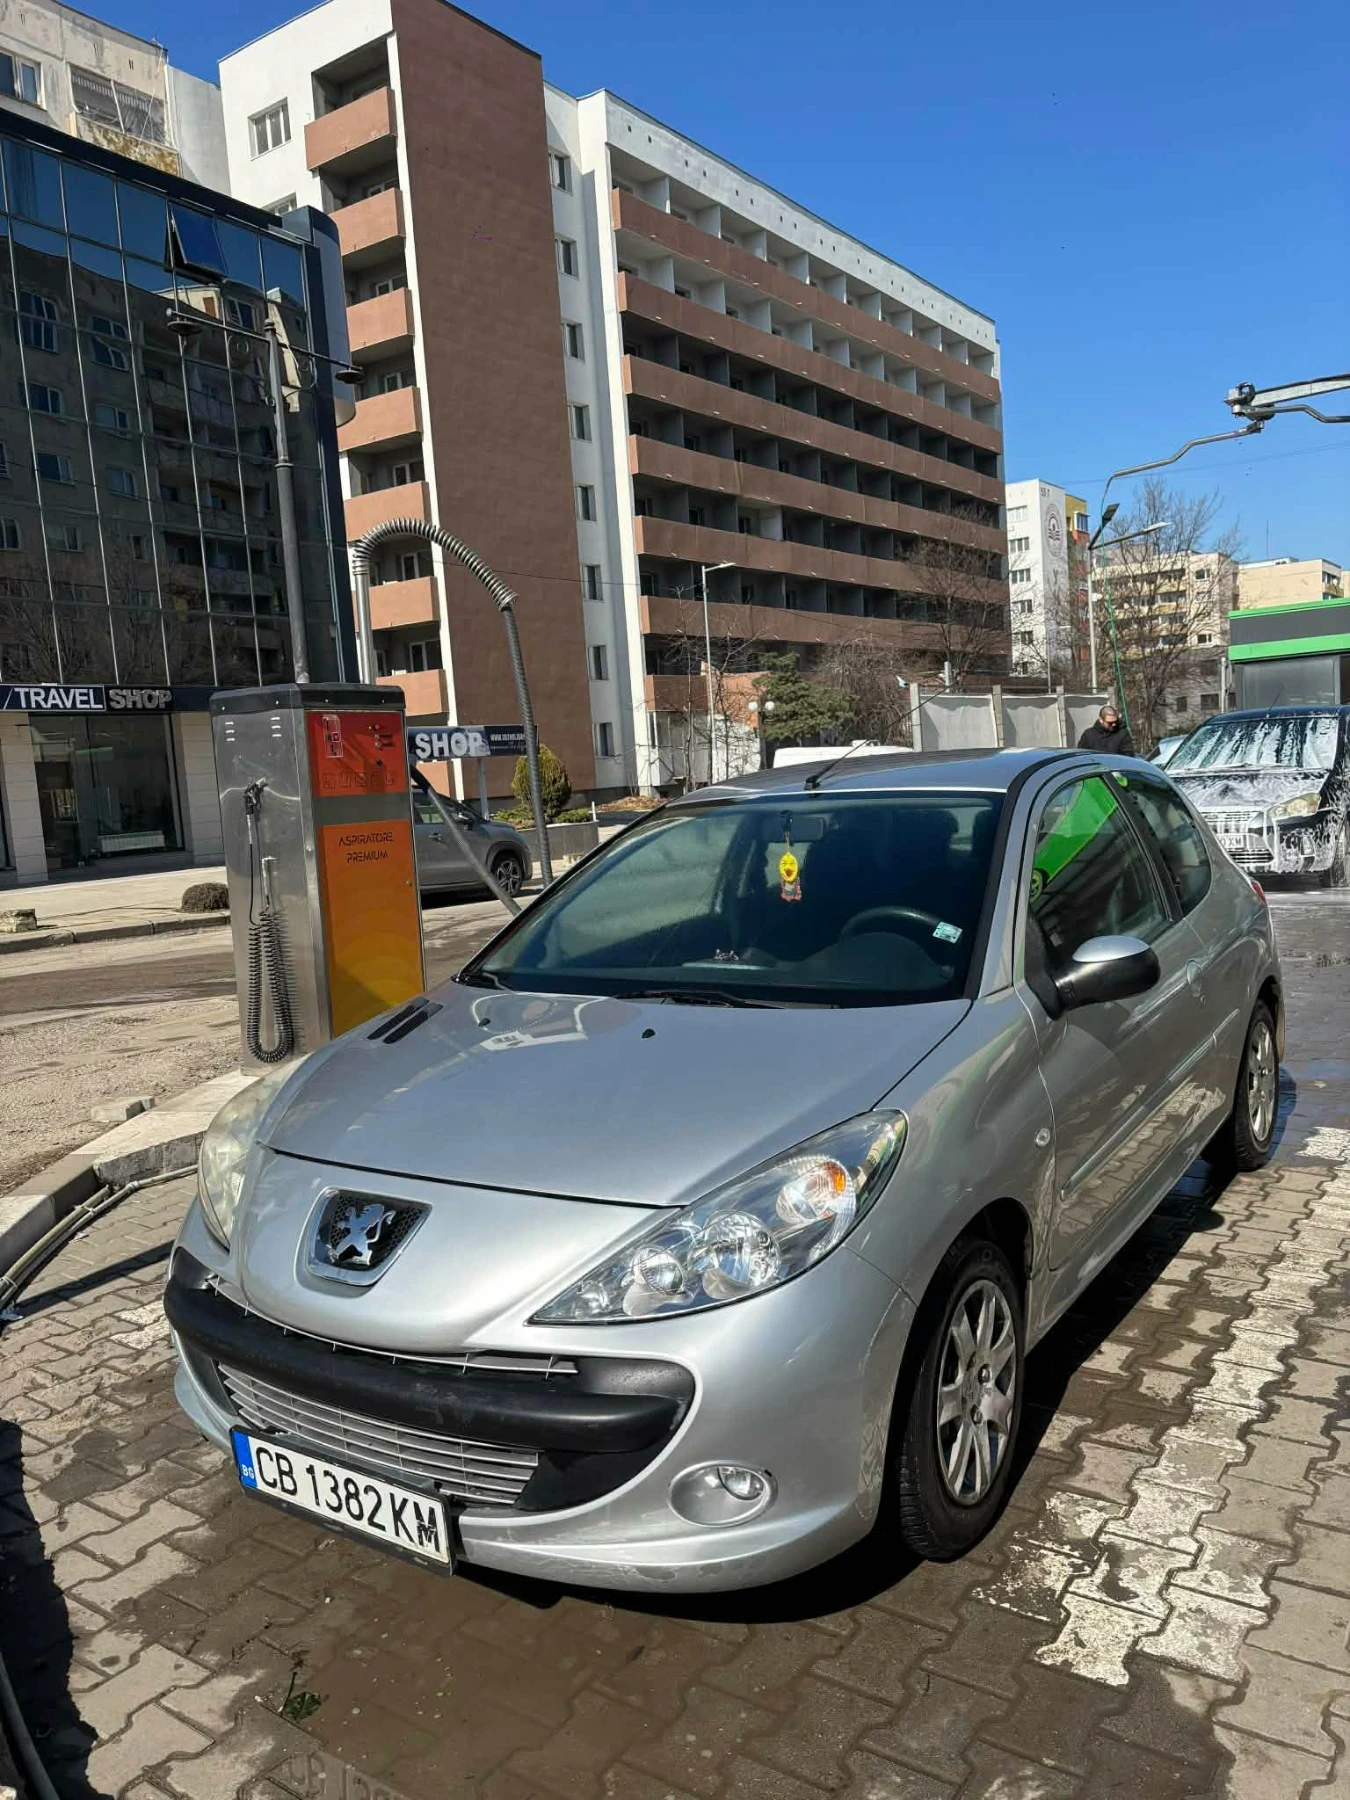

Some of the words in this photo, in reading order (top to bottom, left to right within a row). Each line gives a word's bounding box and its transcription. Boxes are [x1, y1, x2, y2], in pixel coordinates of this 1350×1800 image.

[14, 687, 103, 710] TRAVEL
[109, 688, 173, 709] SHOP
[415, 731, 484, 759] SHOP
[338, 831, 394, 847] ASPIRATORE
[345, 850, 389, 864] PREMIUM
[241, 1464, 255, 1480] BG
